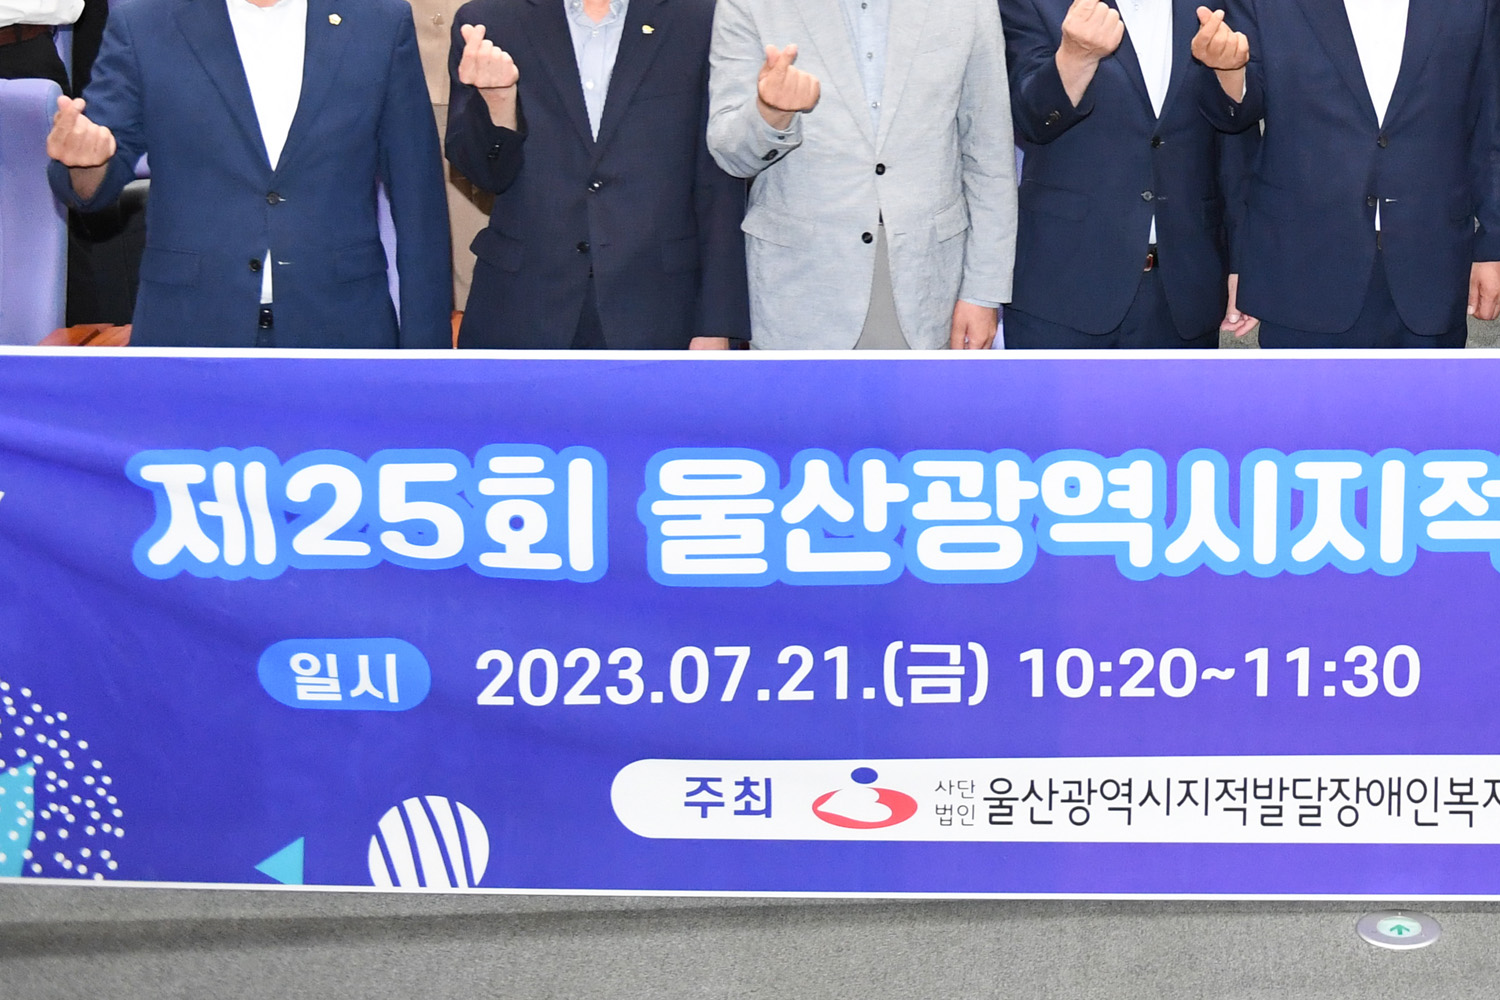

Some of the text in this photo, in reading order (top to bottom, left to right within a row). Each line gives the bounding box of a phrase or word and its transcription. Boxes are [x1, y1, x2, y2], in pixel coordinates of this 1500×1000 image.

[141, 459, 592, 573] 제25회
[290, 653, 399, 703] 일시
[476, 641, 1420, 707] 2023.07.21.(금) 10:20~11:30
[684, 777, 772, 818] 주최
[935, 780, 975, 799] 사단
[936, 804, 974, 826] 법인
